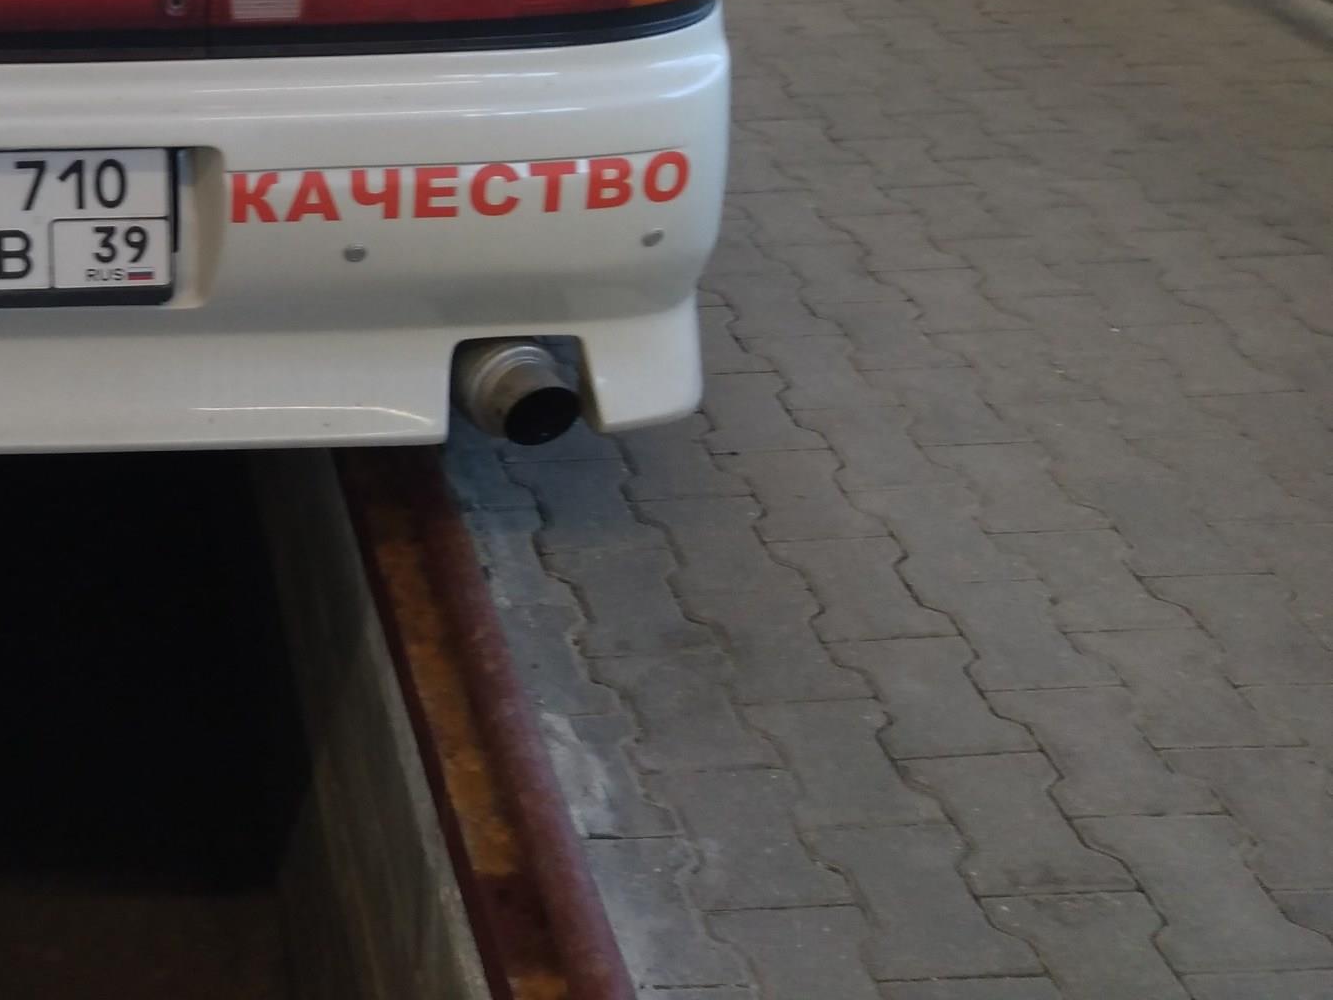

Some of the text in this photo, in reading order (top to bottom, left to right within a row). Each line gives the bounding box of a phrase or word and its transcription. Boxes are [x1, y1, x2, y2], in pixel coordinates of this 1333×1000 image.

[13, 157, 130, 212] 710
[229, 150, 691, 224] КАЧЕСТВО
[92, 225, 151, 265] 39
[85, 267, 126, 283] RUS
